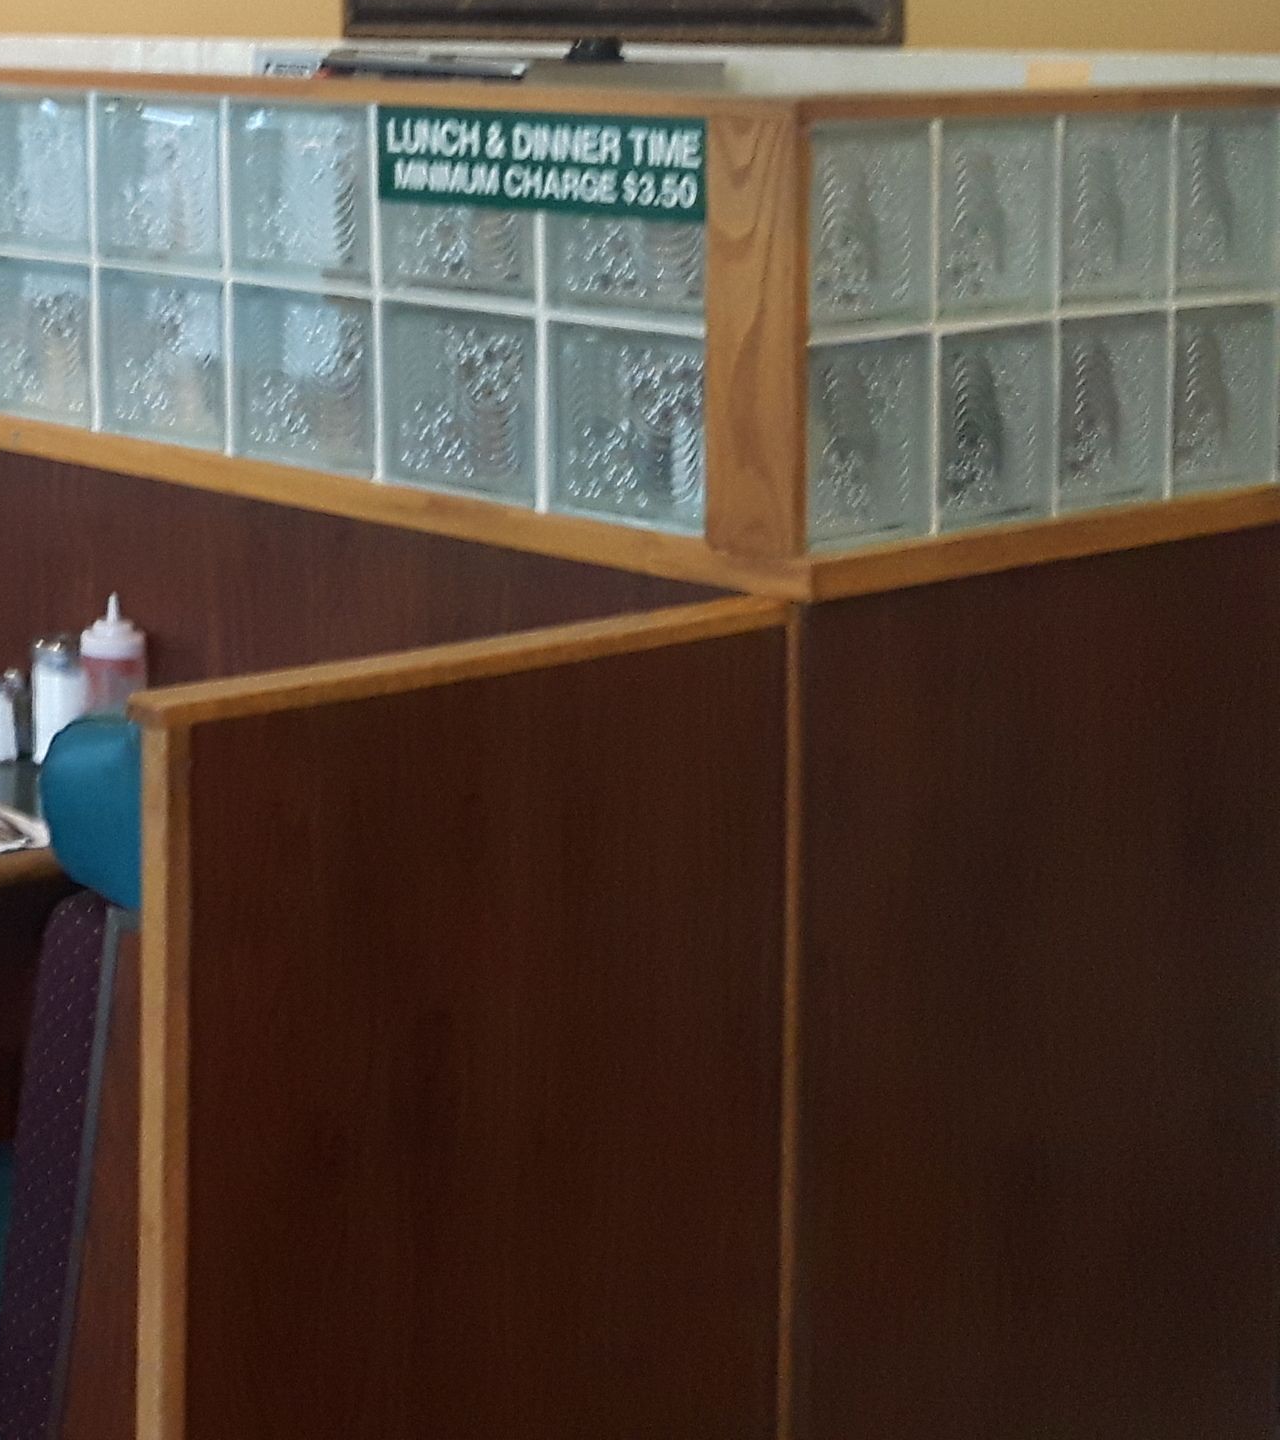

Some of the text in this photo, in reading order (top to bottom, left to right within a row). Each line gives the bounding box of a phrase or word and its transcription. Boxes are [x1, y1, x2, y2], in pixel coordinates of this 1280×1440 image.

[387, 117, 703, 169] LUNCH & DINNER TIME
[394, 159, 698, 210] MINIMUM CHARGE $3.50
